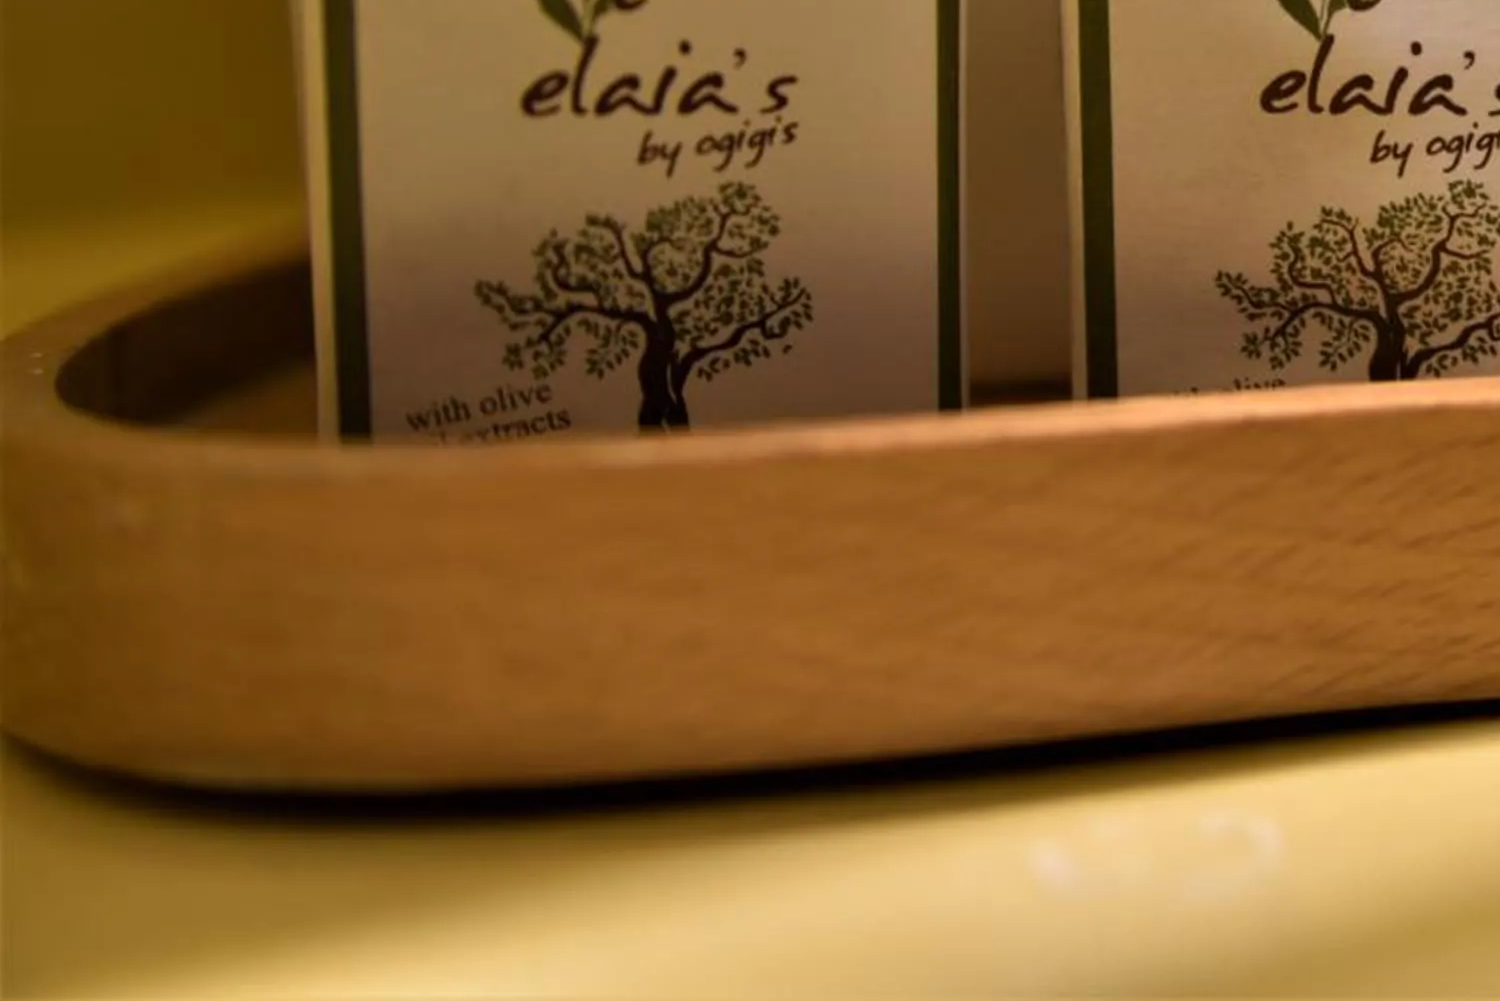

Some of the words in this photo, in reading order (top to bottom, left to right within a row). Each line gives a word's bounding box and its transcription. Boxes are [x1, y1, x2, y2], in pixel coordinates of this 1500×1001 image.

[521, 36, 799, 118] elaia's
[637, 128, 682, 176] by
[695, 117, 799, 172] ogigis
[1370, 130, 1412, 177] by
[405, 394, 472, 433] with
[479, 382, 553, 417] olive
